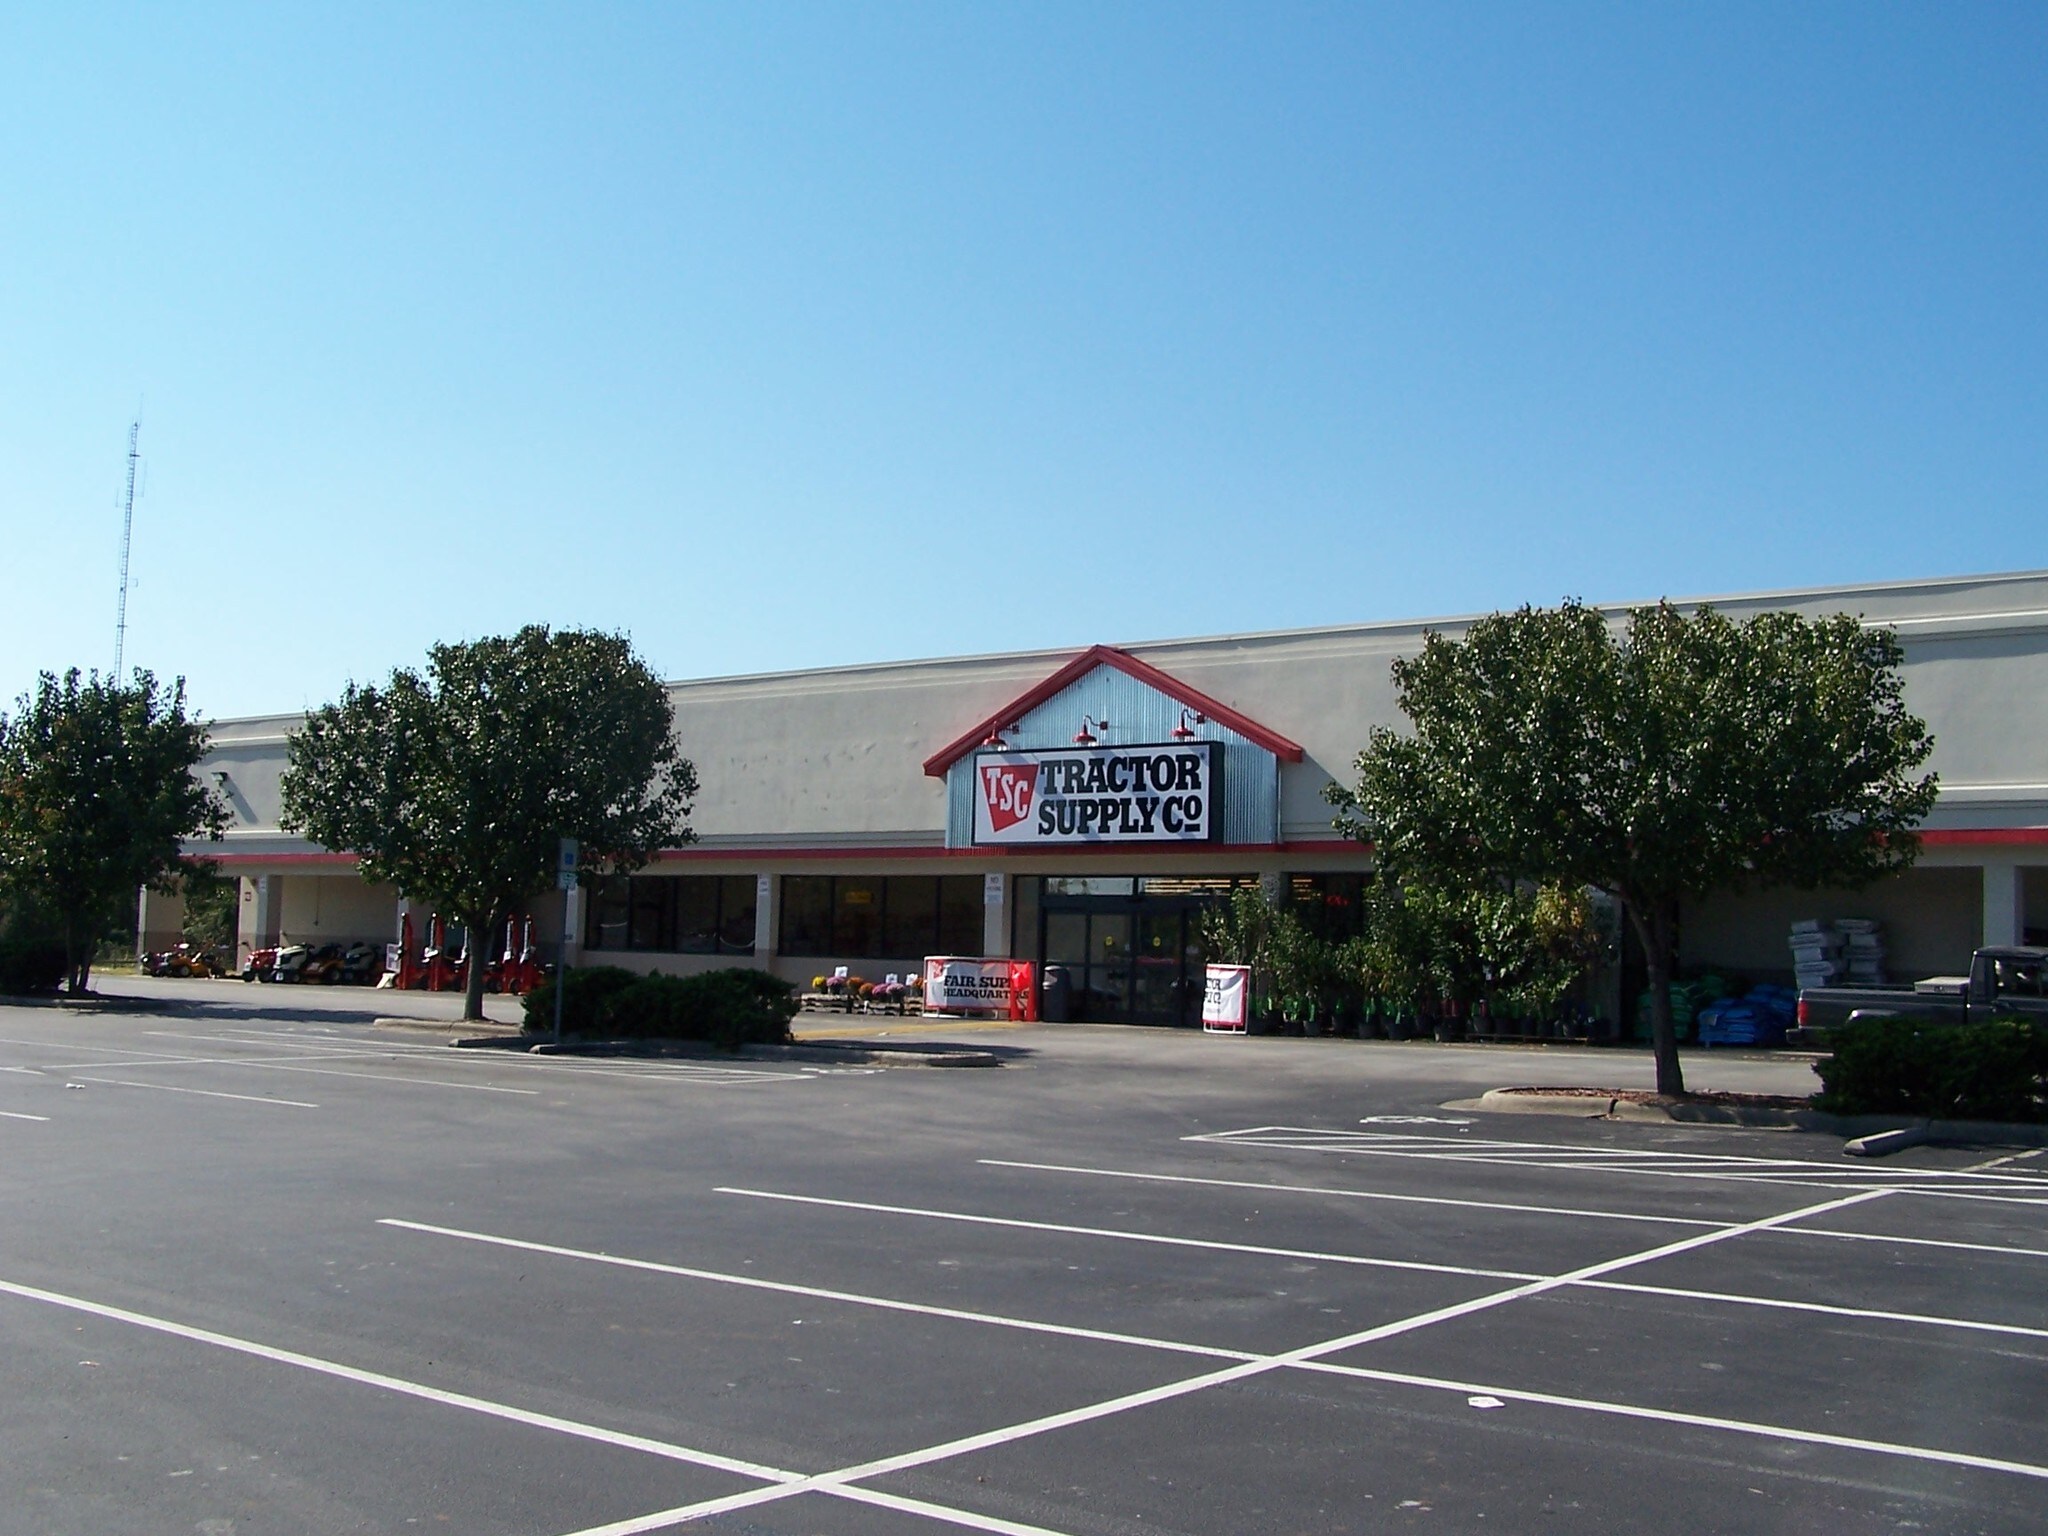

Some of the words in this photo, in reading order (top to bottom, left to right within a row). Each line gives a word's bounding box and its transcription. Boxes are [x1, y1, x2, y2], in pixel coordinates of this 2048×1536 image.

[986, 767, 1028, 819] TSC
[1040, 754, 1201, 794] TRACTOR
[1038, 797, 1160, 835] SUPPLY
[943, 987, 1029, 999] HEADQUARTRS
[944, 975, 976, 988] FAIR
